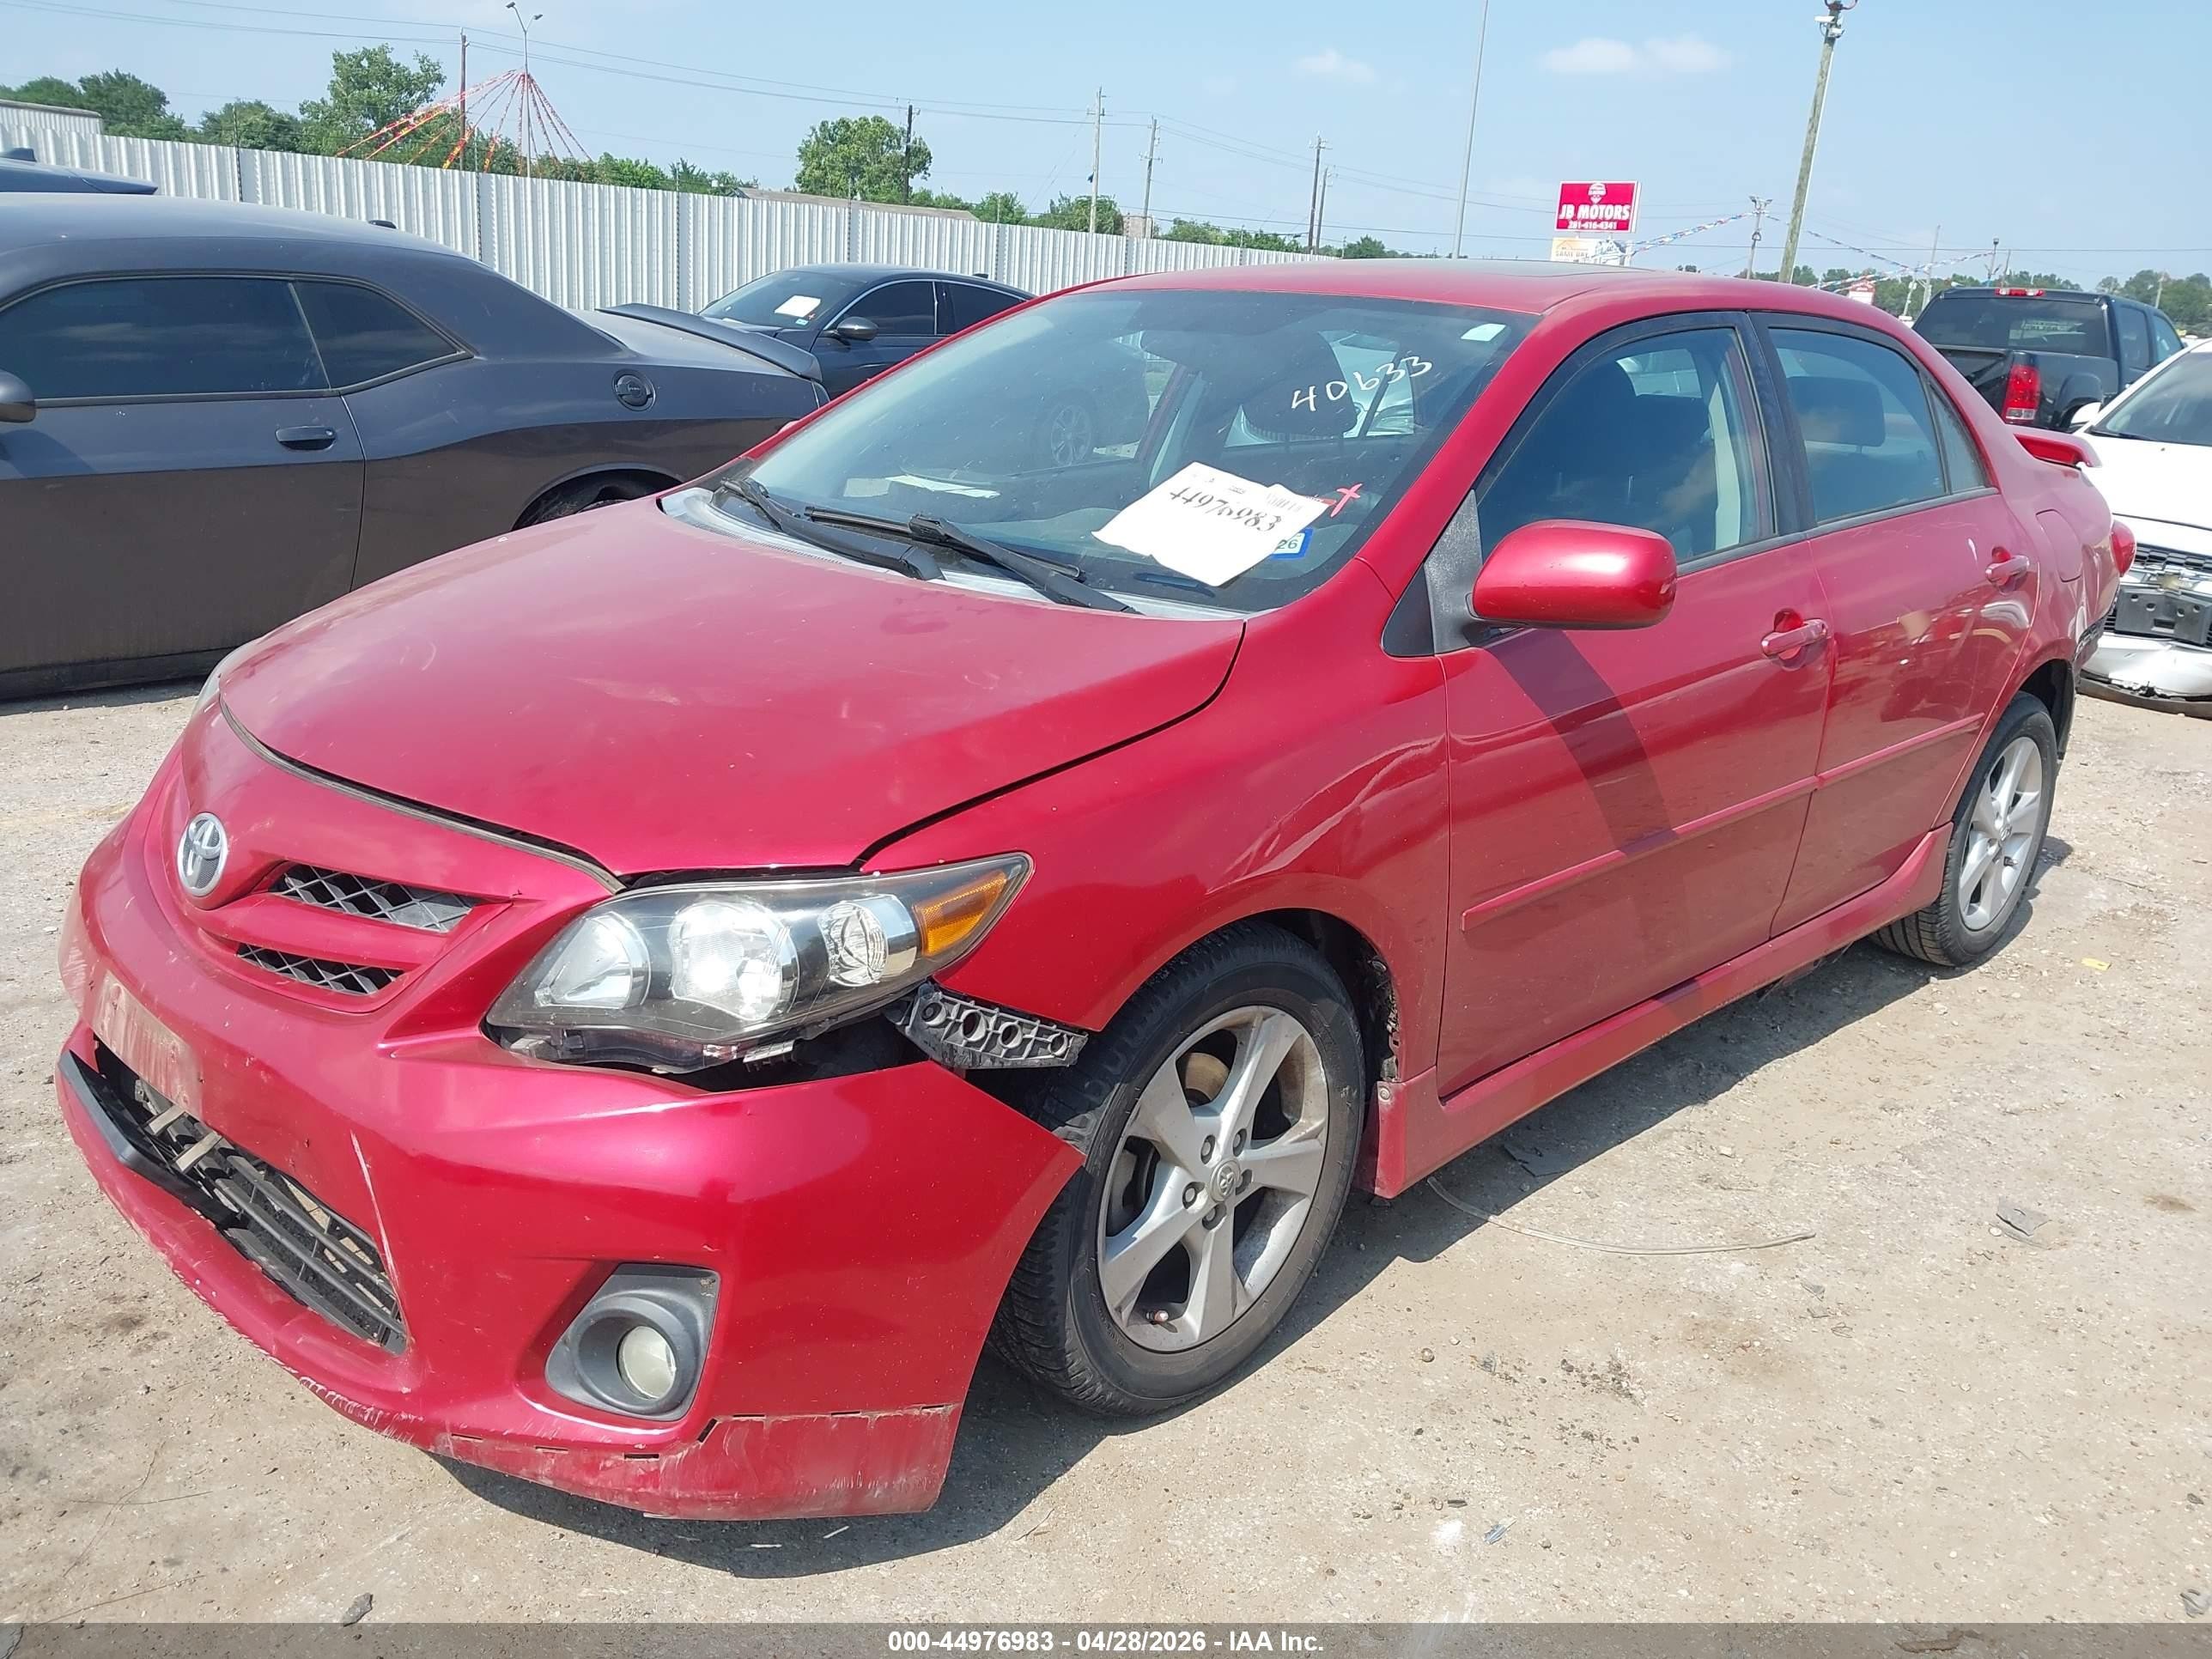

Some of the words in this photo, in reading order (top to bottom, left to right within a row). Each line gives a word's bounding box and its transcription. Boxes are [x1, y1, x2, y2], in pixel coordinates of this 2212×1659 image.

[1559, 204, 1576, 220] JB
[1577, 204, 1631, 221] MOTORS
[1291, 356, 1433, 412] 40633
[1170, 486, 1282, 532] 44976983
[1276, 538, 1299, 550] 26
